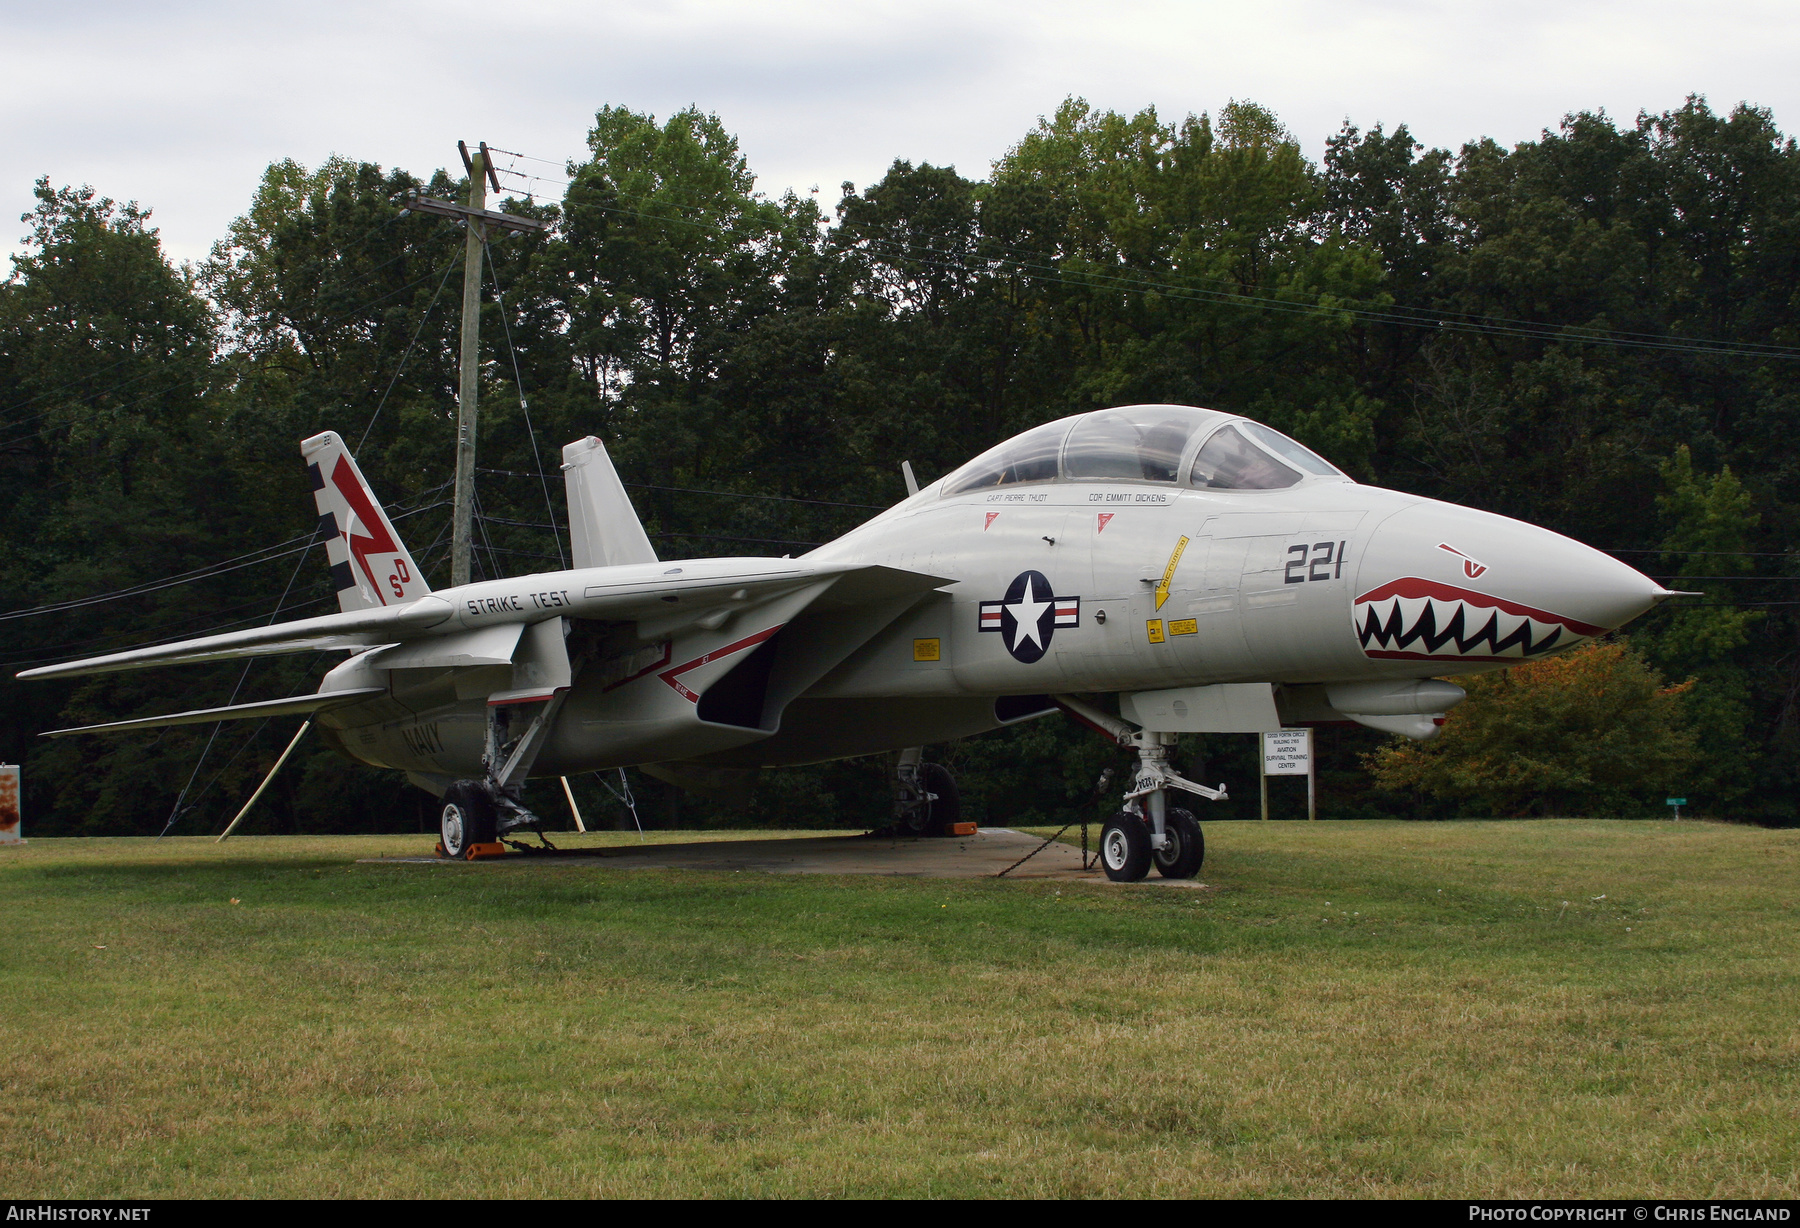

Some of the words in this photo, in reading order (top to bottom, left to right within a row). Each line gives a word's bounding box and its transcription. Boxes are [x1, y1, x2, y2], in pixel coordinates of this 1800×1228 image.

[987, 494, 1003, 502] CAPT
[1004, 494, 1026, 502] PIERRE
[1106, 493, 1132, 502] EMMITT
[1135, 493, 1166, 502] DICKENS
[1284, 540, 1346, 585] 221
[467, 595, 523, 615] STRIKE
[530, 590, 571, 608] TEST
[701, 655, 710, 665] JET
[675, 683, 689, 697] INTAKE
[402, 721, 445, 756] NAVY
